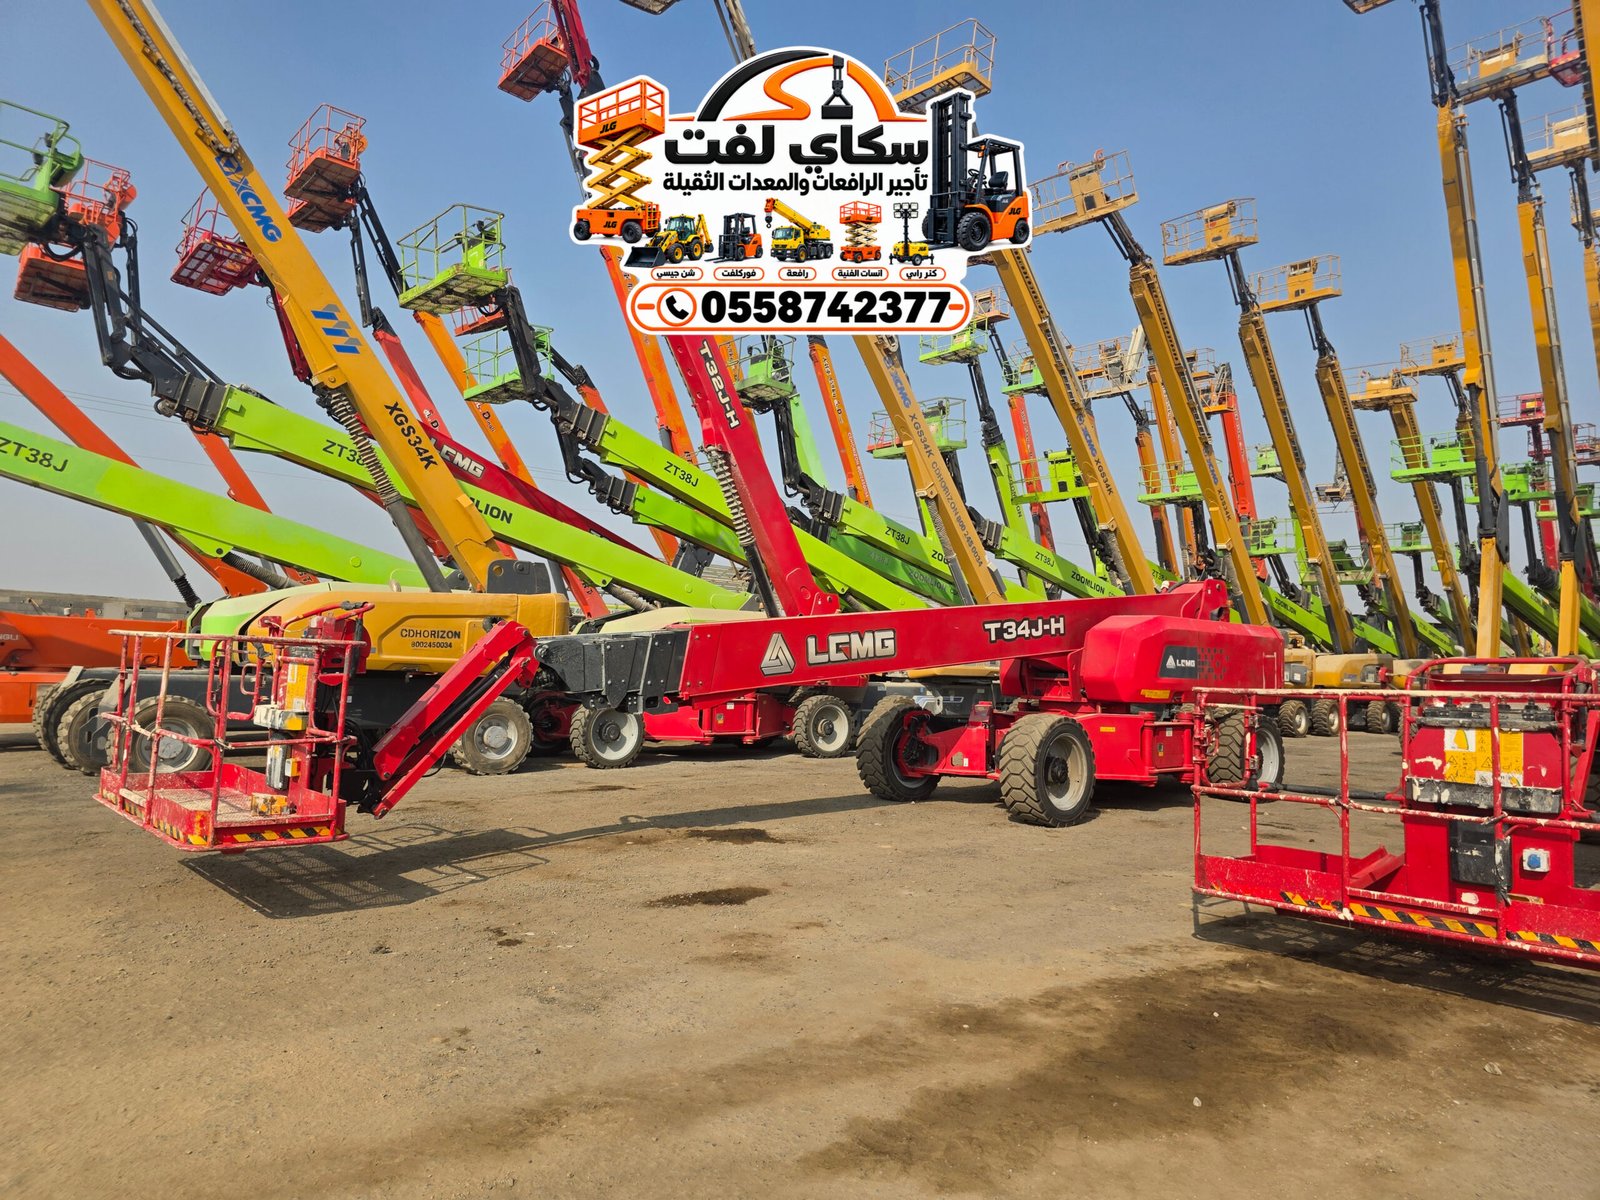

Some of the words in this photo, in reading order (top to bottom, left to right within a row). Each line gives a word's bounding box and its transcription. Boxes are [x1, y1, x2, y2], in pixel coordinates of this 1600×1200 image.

[228, 176, 283, 243] XCMG
[699, 339, 740, 429] T32J-H
[0, 436, 69, 473] ZT38J
[322, 439, 366, 466] ZT38
[384, 402, 438, 470] XGS34K
[663, 460, 699, 487] ZT38J
[908, 413, 935, 458] XGS34K
[931, 461, 959, 516] CDHORIZON
[1094, 458, 1114, 495] XGS34K
[885, 526, 911, 545] ZT38J
[1035, 551, 1055, 568] ZT38J
[1071, 570, 1106, 595] ZOOMLION
[400, 628, 461, 639] CDHORIZON
[983, 616, 1065, 643] T34J-H
